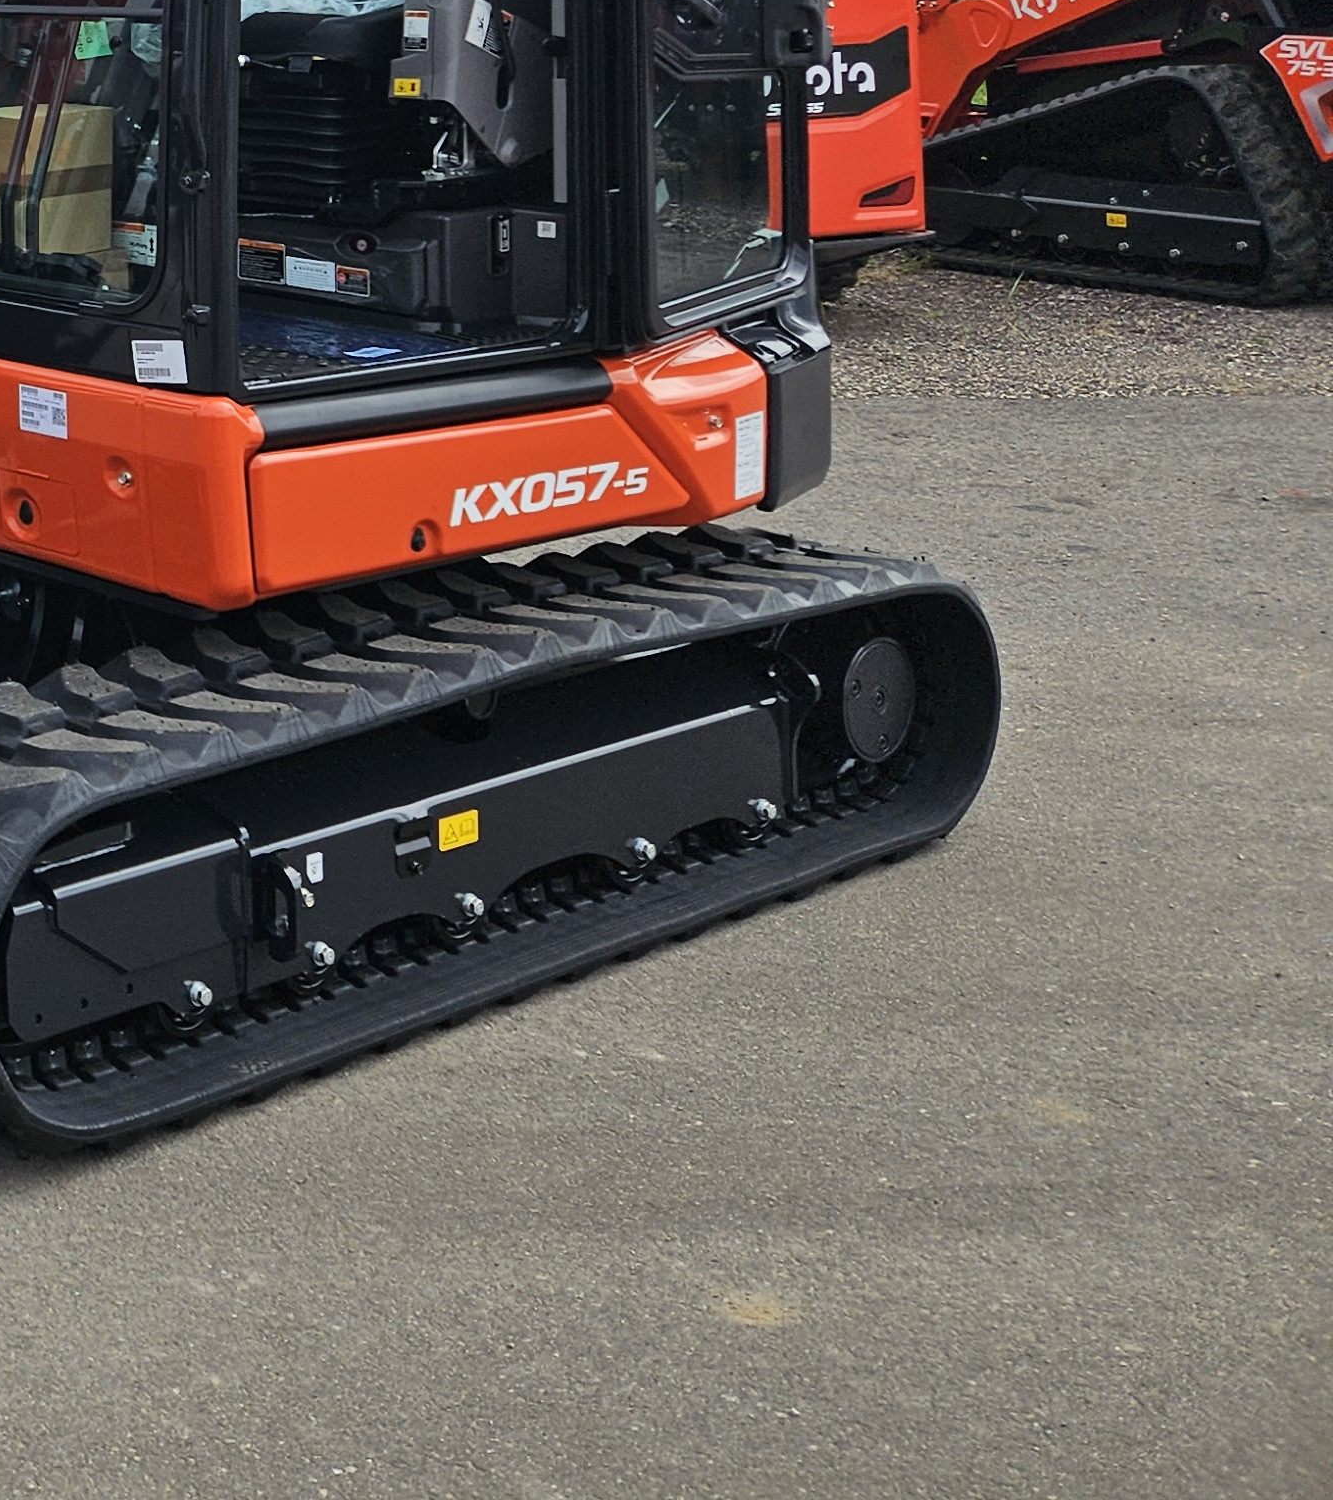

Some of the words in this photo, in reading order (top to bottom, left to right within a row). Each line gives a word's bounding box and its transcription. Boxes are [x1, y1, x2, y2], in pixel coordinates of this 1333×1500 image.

[1276, 40, 1333, 60] SVL
[1286, 59, 1333, 78] 75-3
[449, 461, 649, 527] KX057-5
